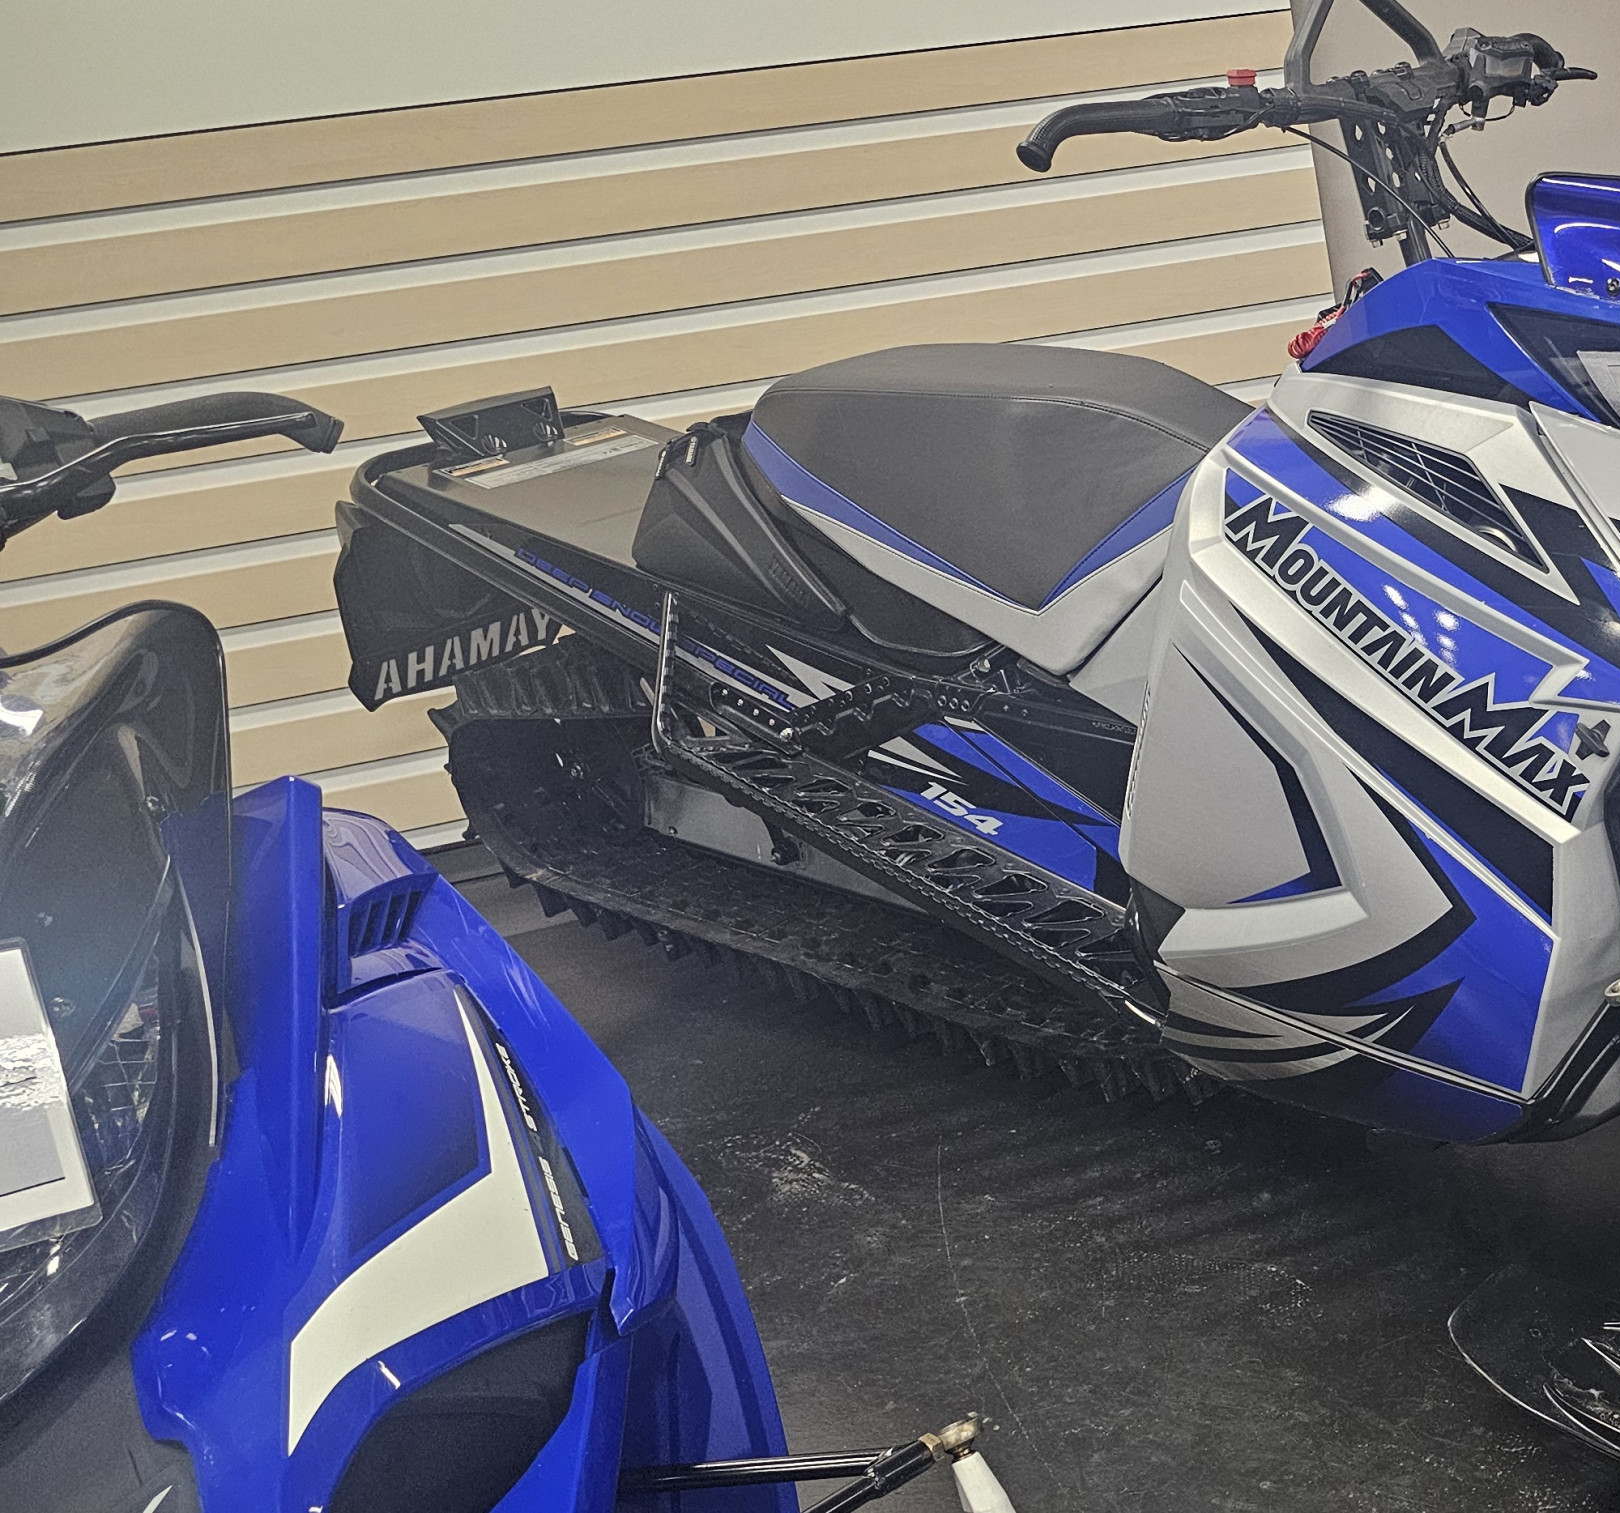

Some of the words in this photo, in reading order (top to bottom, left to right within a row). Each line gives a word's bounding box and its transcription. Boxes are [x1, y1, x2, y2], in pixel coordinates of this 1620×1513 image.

[515, 547, 591, 593] DEEP
[920, 781, 1004, 836] 154
[495, 1042, 538, 1132] STROKE
[538, 1156, 579, 1261] GENESIS
